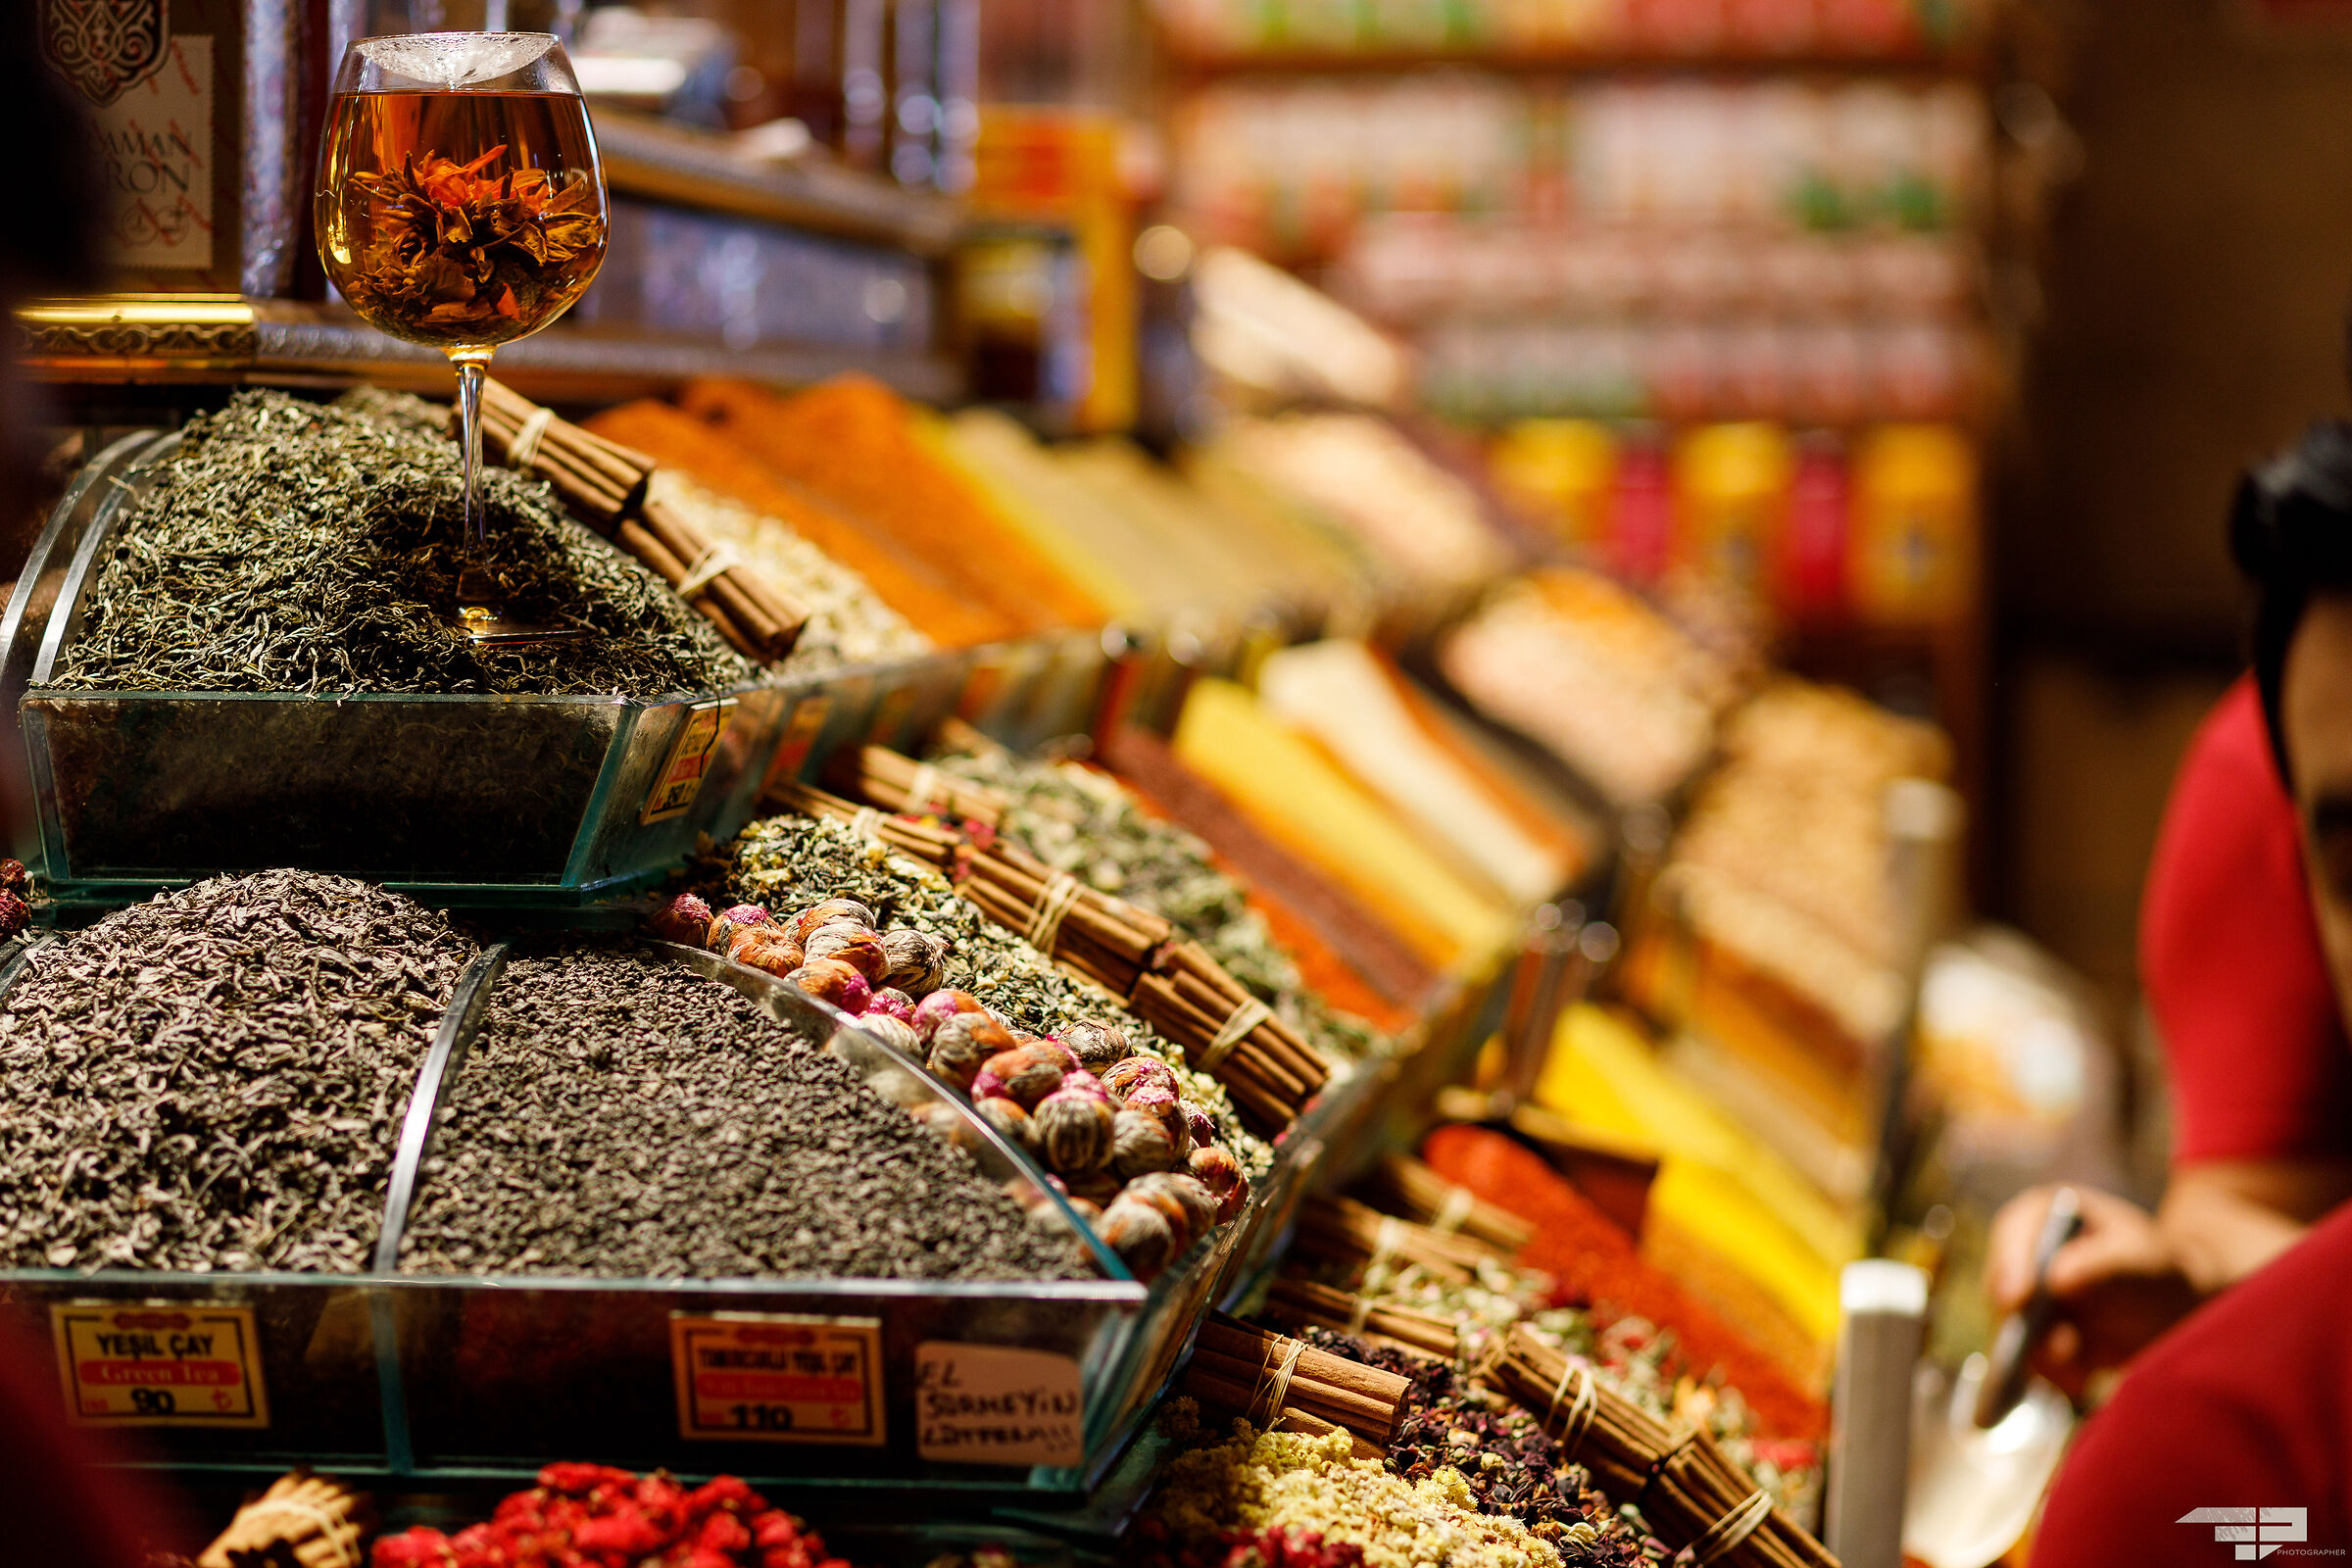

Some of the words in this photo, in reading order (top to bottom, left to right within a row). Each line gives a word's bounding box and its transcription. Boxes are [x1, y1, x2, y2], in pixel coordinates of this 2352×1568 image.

[169, 1334, 215, 1361] ÇAY
[100, 1363, 172, 1382] Green
[183, 1363, 220, 1382] Tea
[130, 1387, 175, 1414] 90
[731, 1404, 793, 1430] 110
